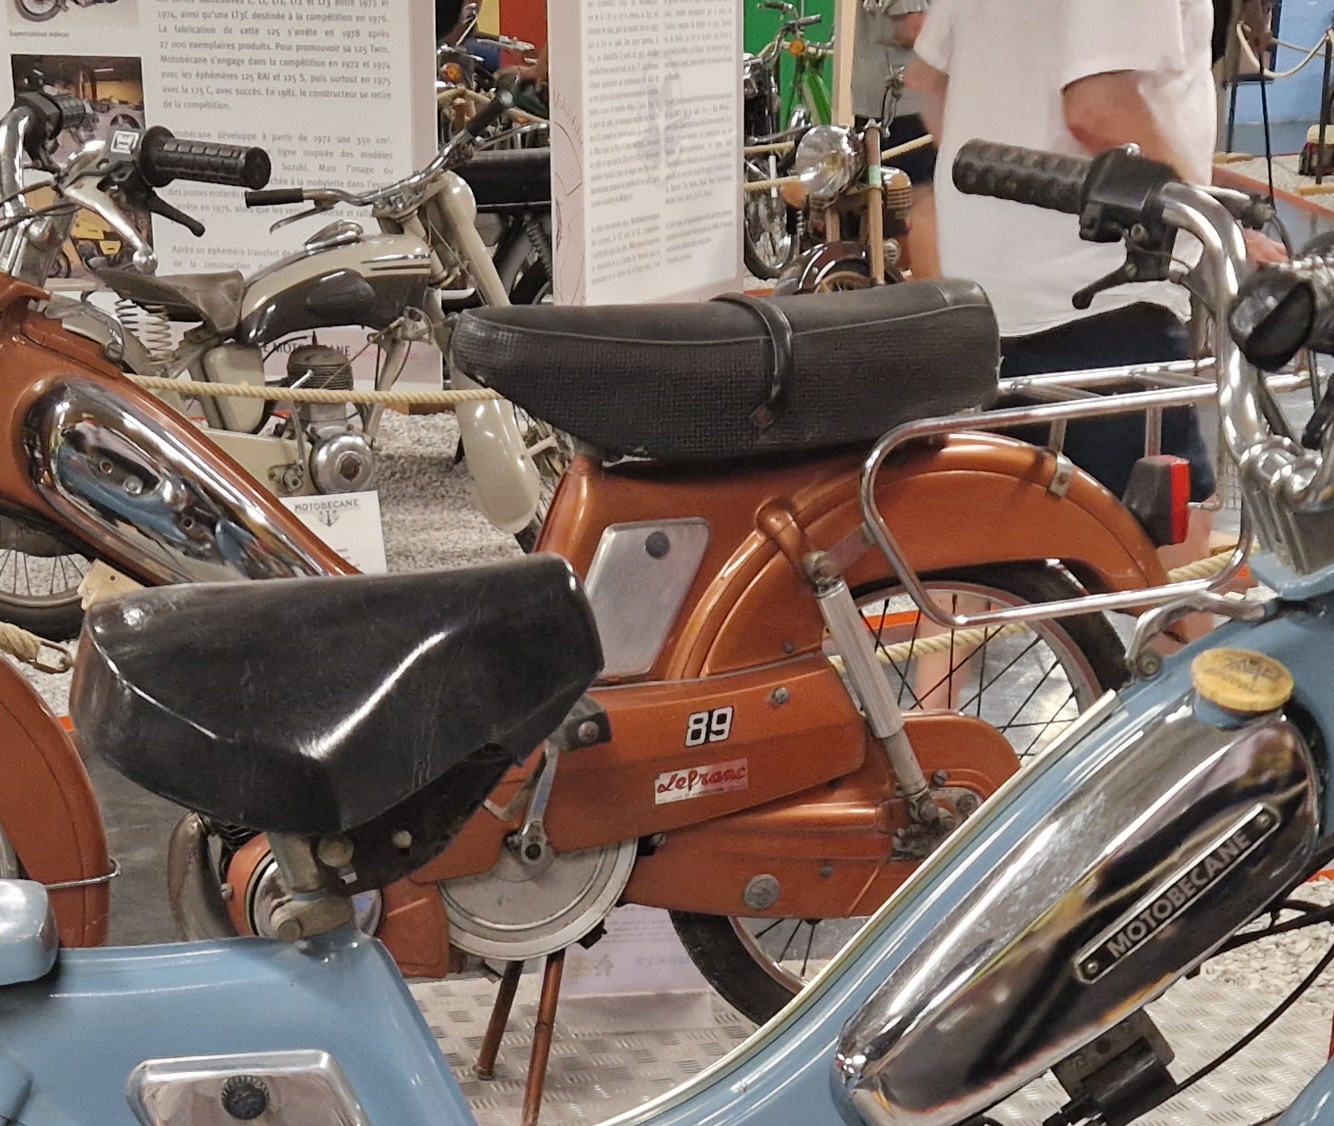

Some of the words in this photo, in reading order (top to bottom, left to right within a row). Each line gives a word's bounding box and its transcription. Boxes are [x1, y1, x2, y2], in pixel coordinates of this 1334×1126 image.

[294, 498, 360, 512] MOTOBECANE
[685, 706, 734, 748] 89
[1105, 829, 1252, 959] MOTOBECANE
